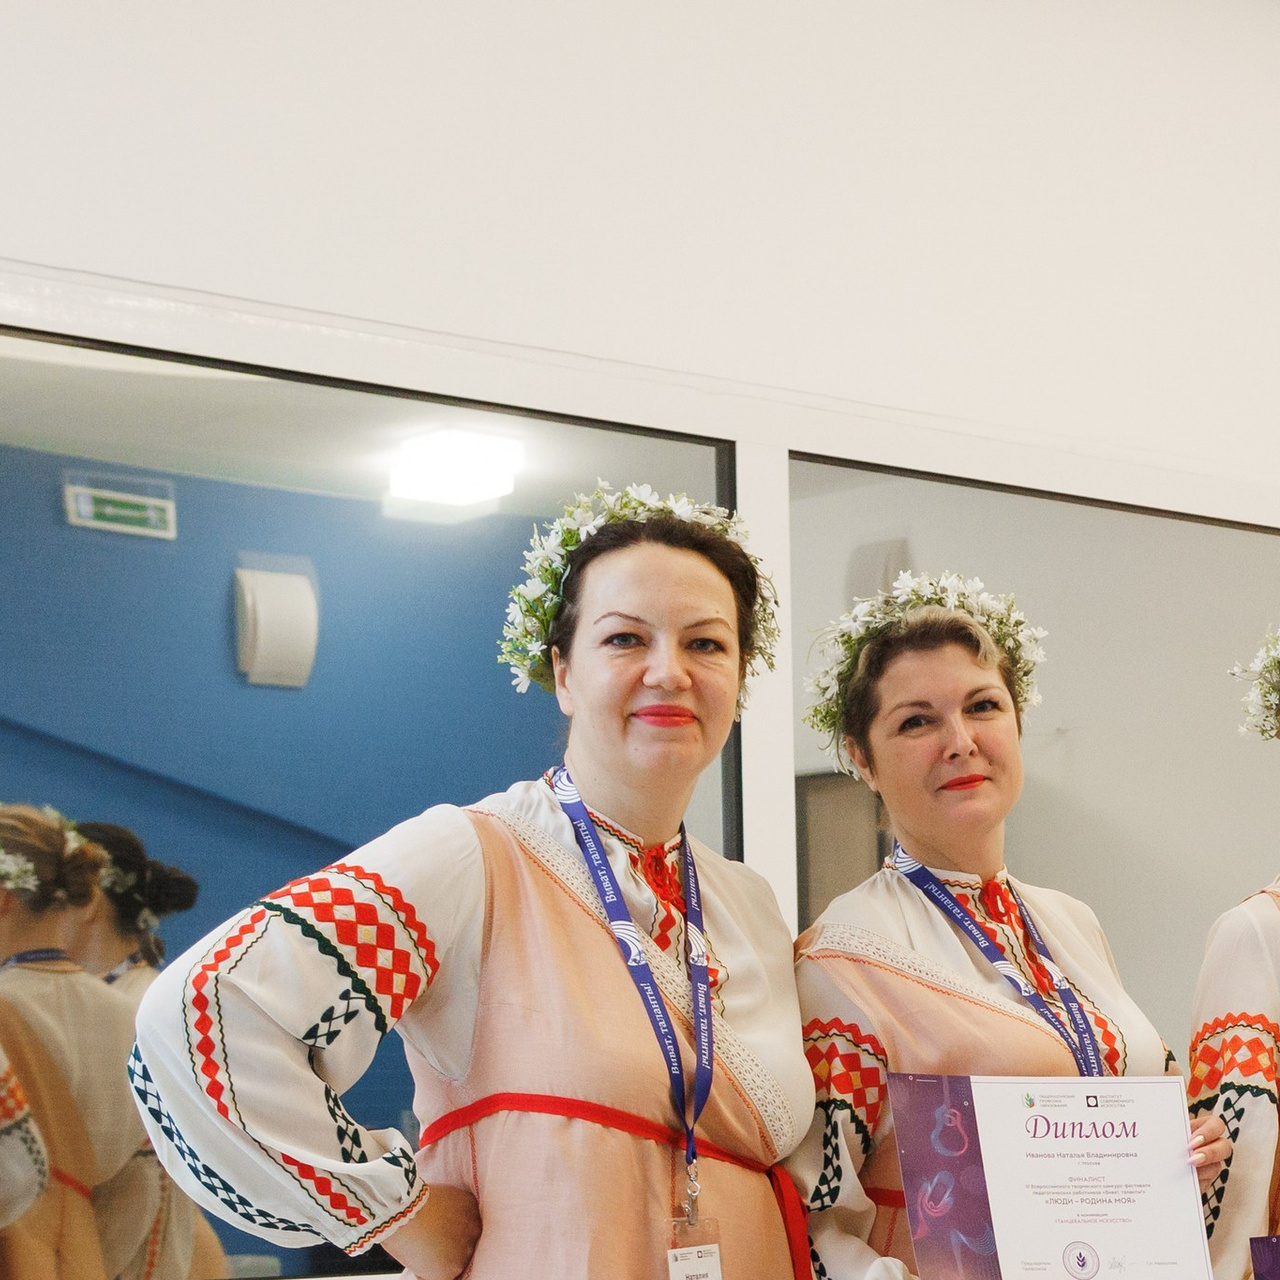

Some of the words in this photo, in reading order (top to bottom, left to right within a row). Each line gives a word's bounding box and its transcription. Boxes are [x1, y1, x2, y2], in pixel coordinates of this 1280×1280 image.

[573, 819, 602, 866] таланты!
[597, 866, 617, 903] Виват,
[924, 881, 963, 919] таланты!
[962, 918, 988, 948] Виват,
[640, 982, 669, 1034] таланты!
[697, 982, 707, 1016] Виват,
[664, 1035, 679, 1074] Виват,
[701, 1018, 710, 1069] таланты!
[1069, 1003, 1086, 1032] Виват,
[1082, 1033, 1099, 1077] таланты
[1025, 1115, 1139, 1139] Диплом
[1087, 1151, 1138, 1159] Владимировна
